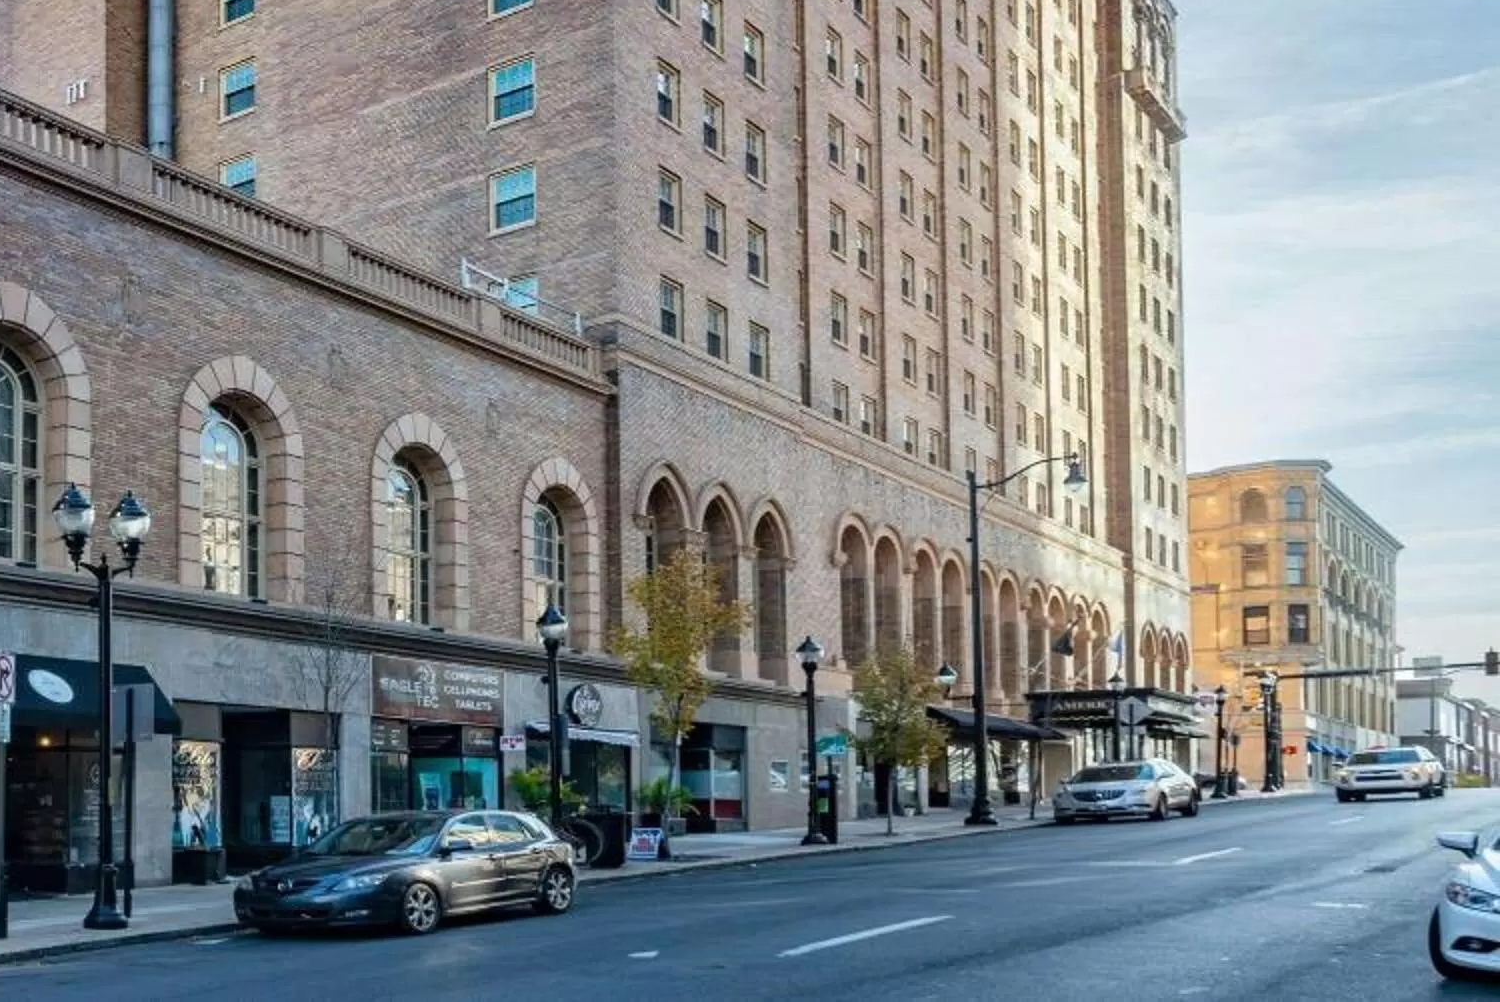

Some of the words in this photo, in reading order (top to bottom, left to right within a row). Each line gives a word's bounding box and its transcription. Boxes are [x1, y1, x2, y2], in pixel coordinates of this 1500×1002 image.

[443, 669, 499, 685] COMPUTERS
[380, 677, 422, 695] EAGLE
[417, 696, 440, 709] TEC
[454, 699, 493, 711] TABLETS
